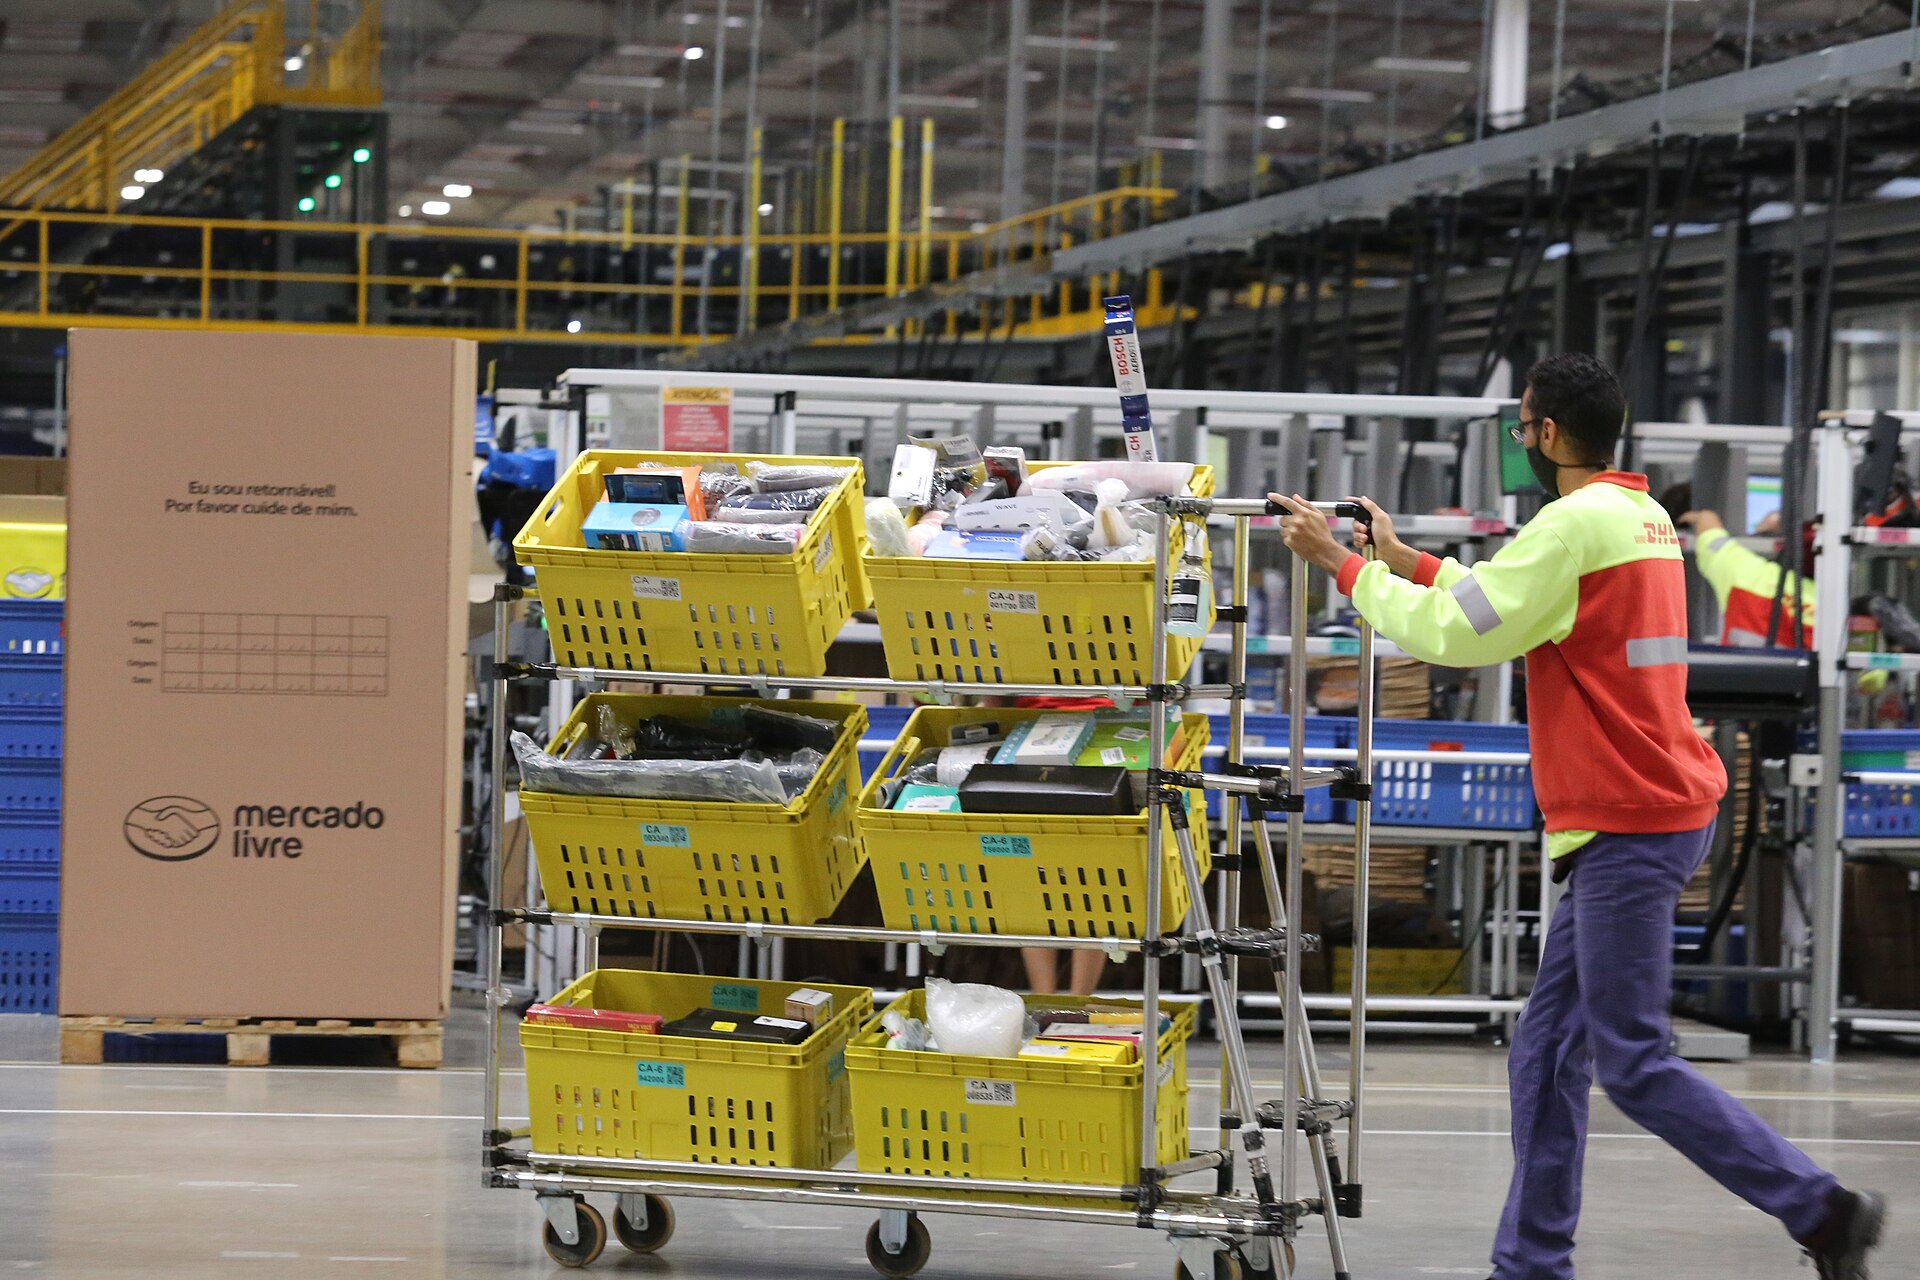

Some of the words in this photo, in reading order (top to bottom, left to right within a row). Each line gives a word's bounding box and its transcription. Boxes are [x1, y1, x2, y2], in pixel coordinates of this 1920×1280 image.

[1113, 337, 1129, 376] BOSCH
[188, 481, 208, 495] Eu
[212, 484, 242, 496] sou
[246, 483, 336, 498] retornável!
[164, 500, 192, 513] Por
[196, 499, 237, 514] favor
[242, 502, 288, 515] cuide
[291, 502, 312, 516] de
[315, 504, 358, 517] mim.
[1643, 522, 1679, 545] DHL
[632, 575, 650, 585] CA
[233, 801, 385, 830] mercado
[646, 824, 661, 834] CA
[232, 830, 304, 859] livre
